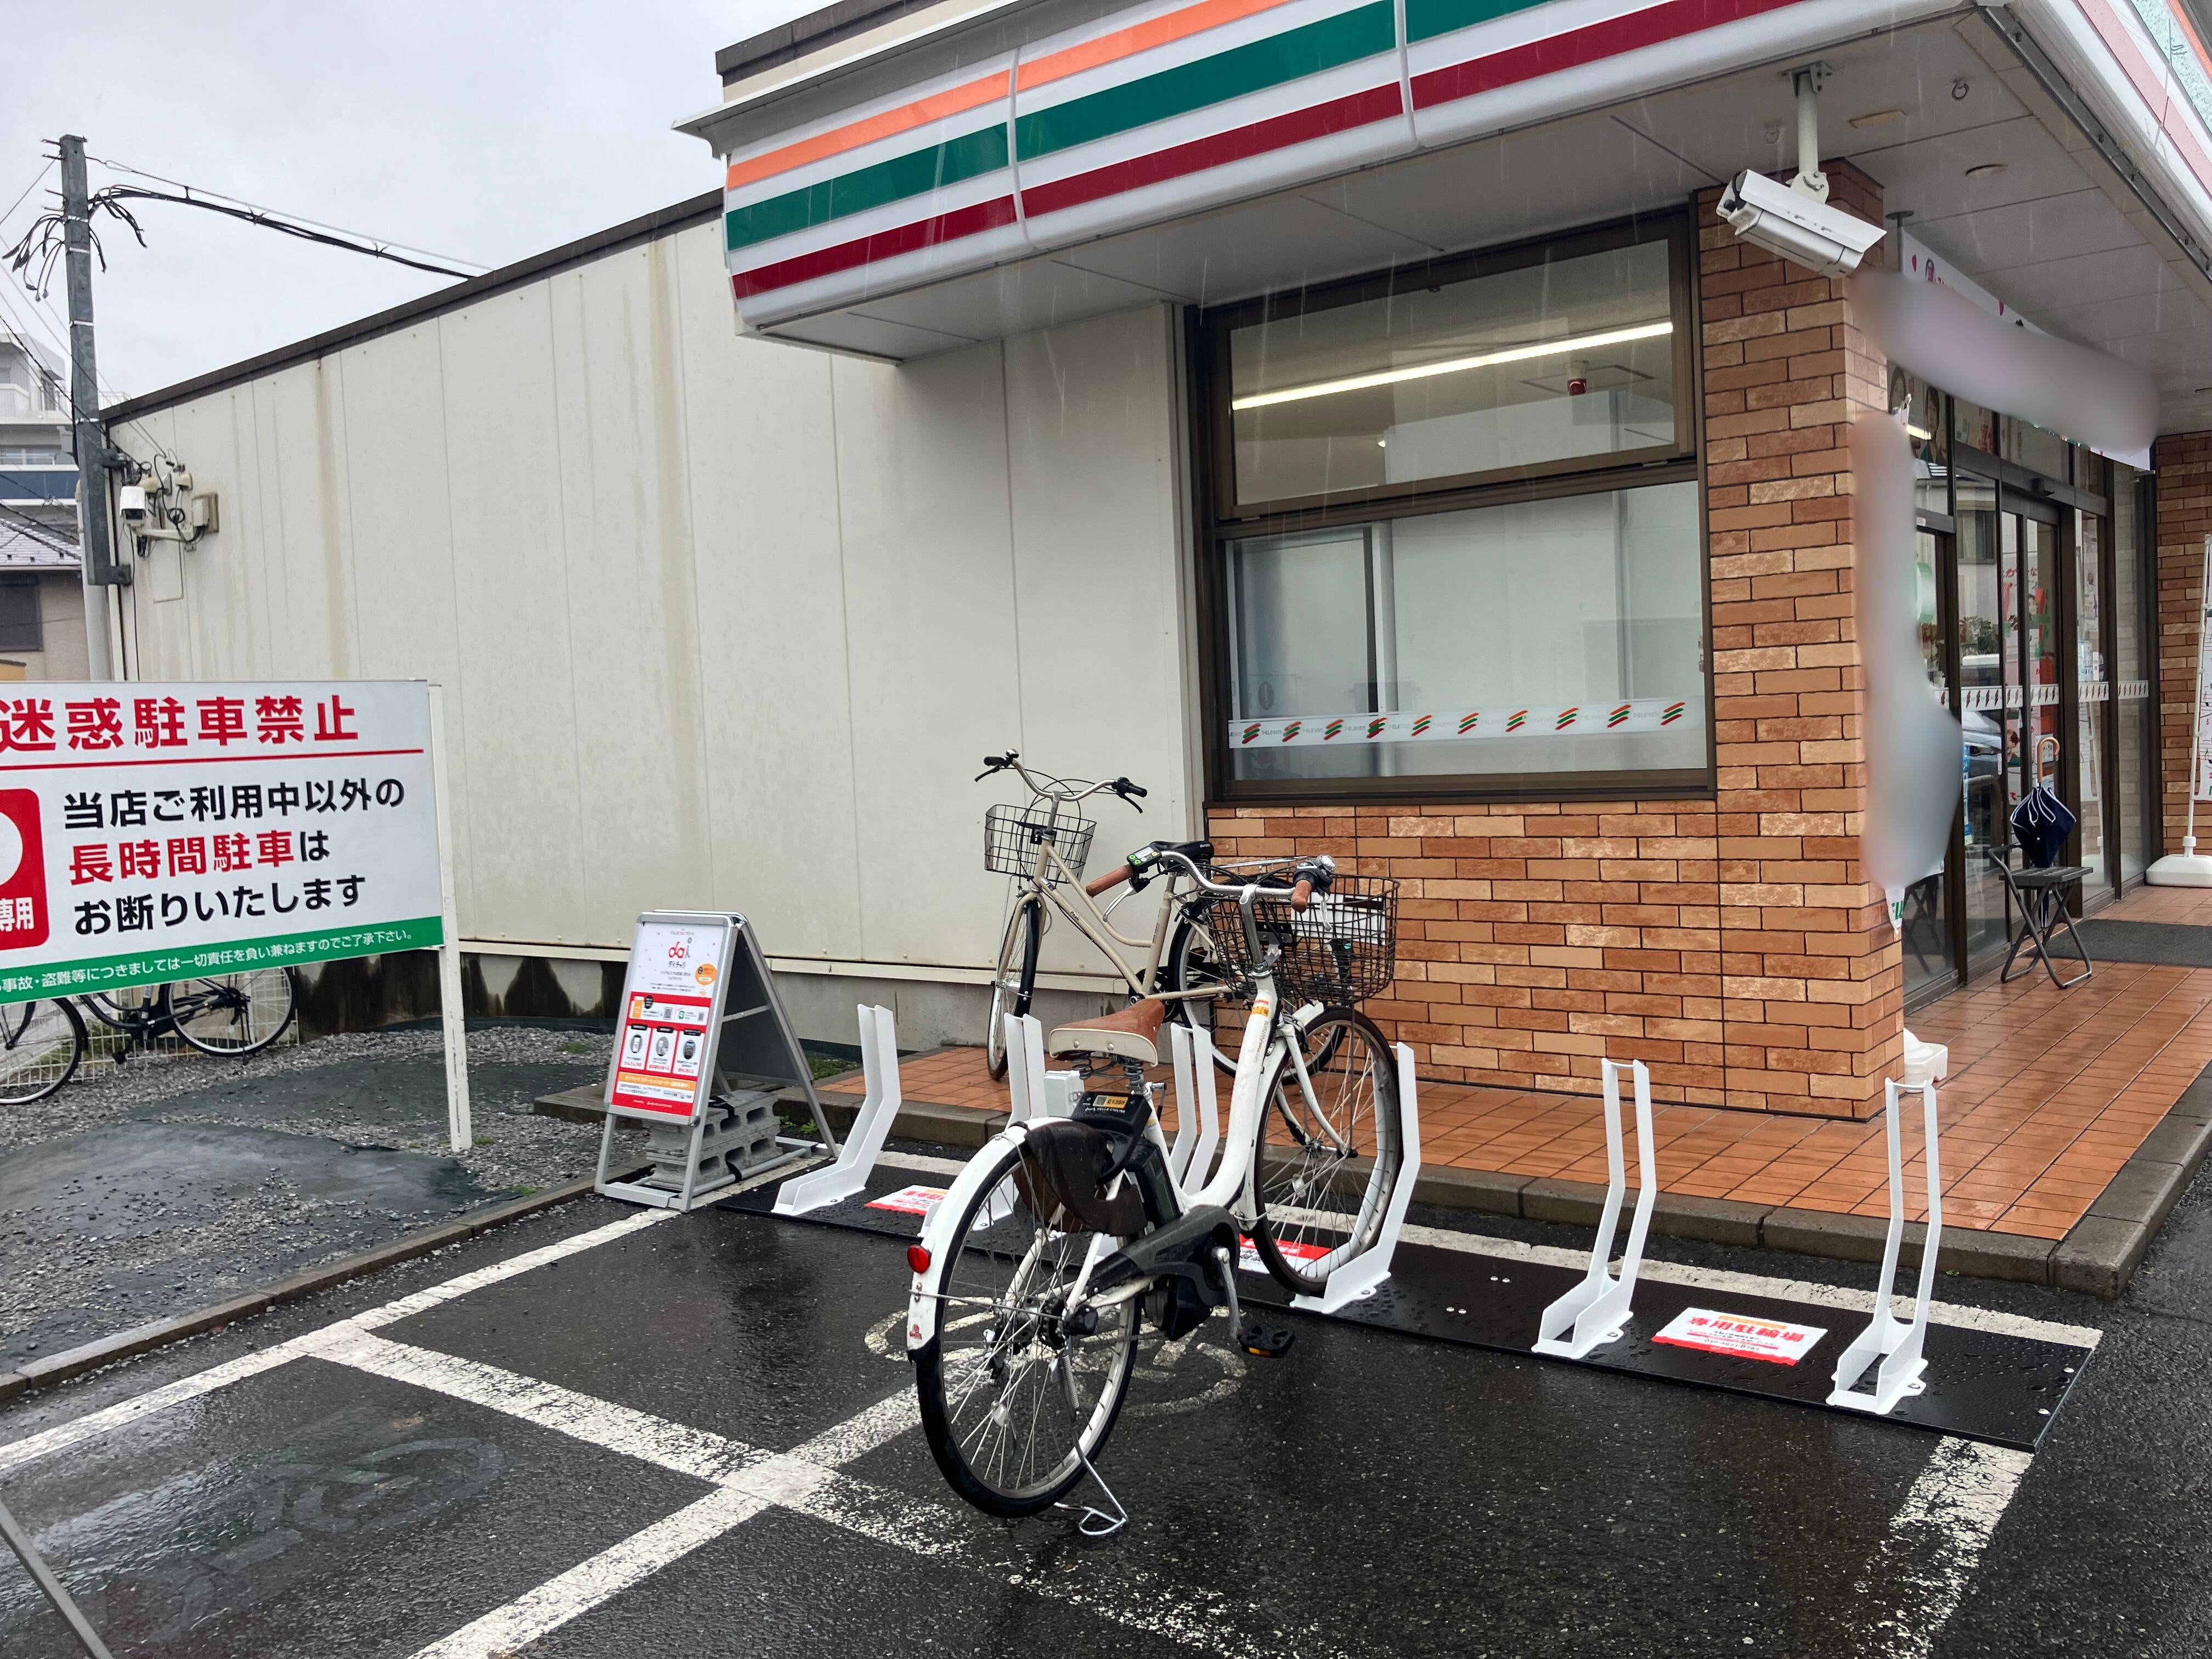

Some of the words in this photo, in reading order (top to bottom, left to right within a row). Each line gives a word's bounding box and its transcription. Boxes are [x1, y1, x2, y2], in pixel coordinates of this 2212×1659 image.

[0, 695, 359, 751] 迷惑駐車禁止
[64, 778, 405, 829] 当店ご利用中以外の
[69, 830, 330, 885] 長時間駐車は
[74, 874, 366, 935] お断りいたします
[0, 929, 412, 993] 事故・盗難等につきましては一切責任を負い兼ねますのでご了承下さい。
